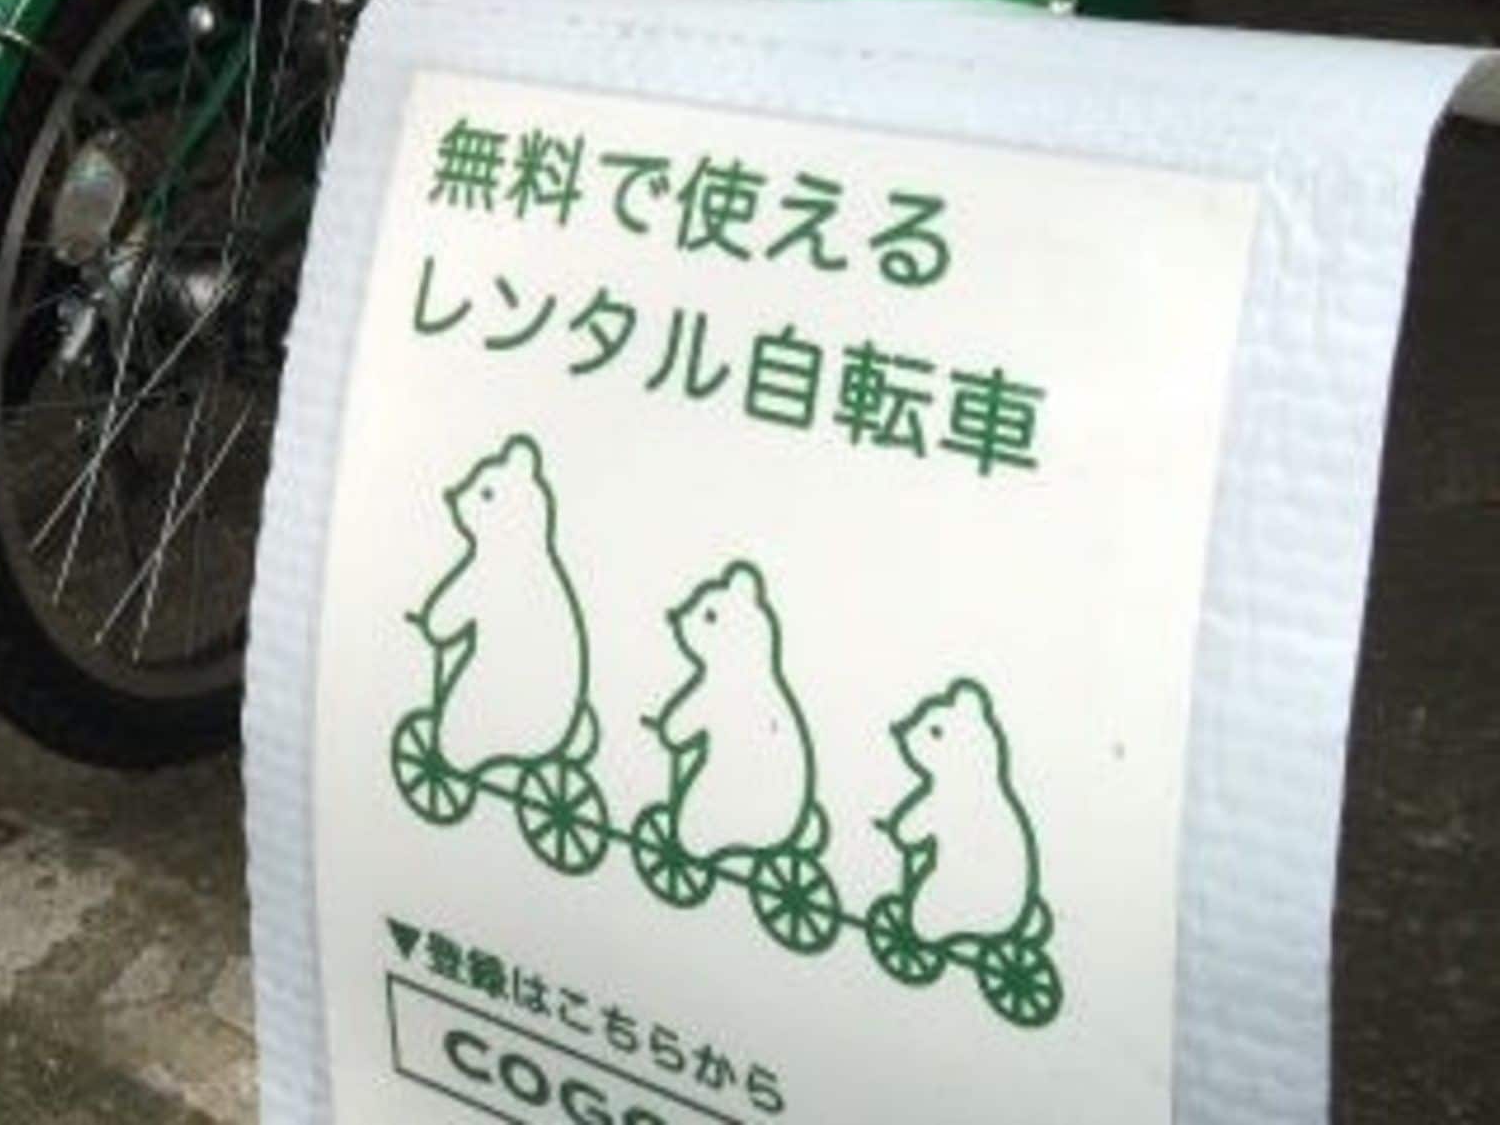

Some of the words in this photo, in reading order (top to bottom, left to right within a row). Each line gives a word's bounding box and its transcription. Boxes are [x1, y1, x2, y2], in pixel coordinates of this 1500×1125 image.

[427, 117, 952, 289] 無料で使える
[412, 256, 1047, 476] レンタル自転車
[426, 930, 786, 1115] 登録はこちらから
